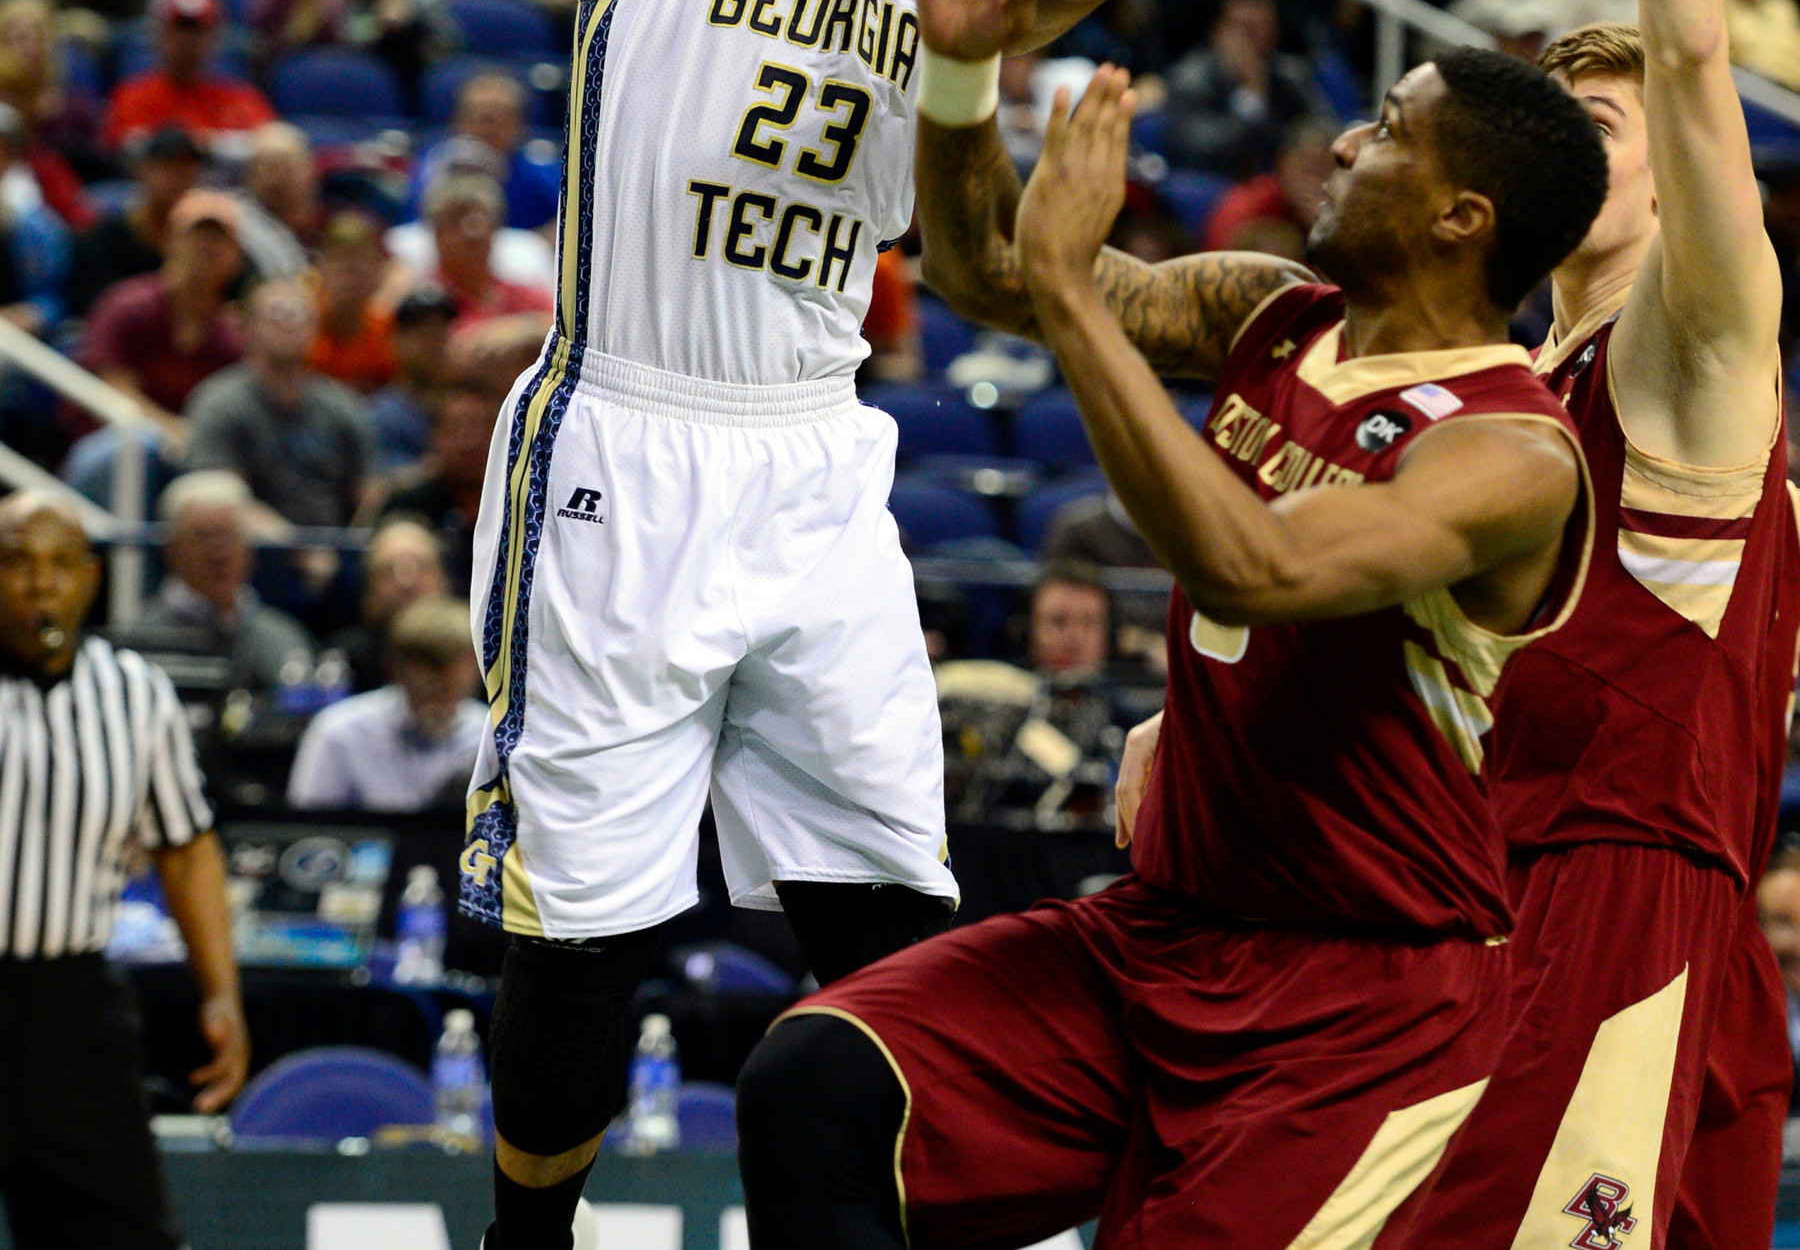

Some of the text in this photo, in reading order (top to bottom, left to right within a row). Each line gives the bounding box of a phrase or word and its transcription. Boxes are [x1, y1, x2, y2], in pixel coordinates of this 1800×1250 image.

[730, 60, 874, 186] 23
[687, 180, 864, 293] TECH
[557, 508, 605, 525] RUSSELL
[459, 838, 498, 888] GT
